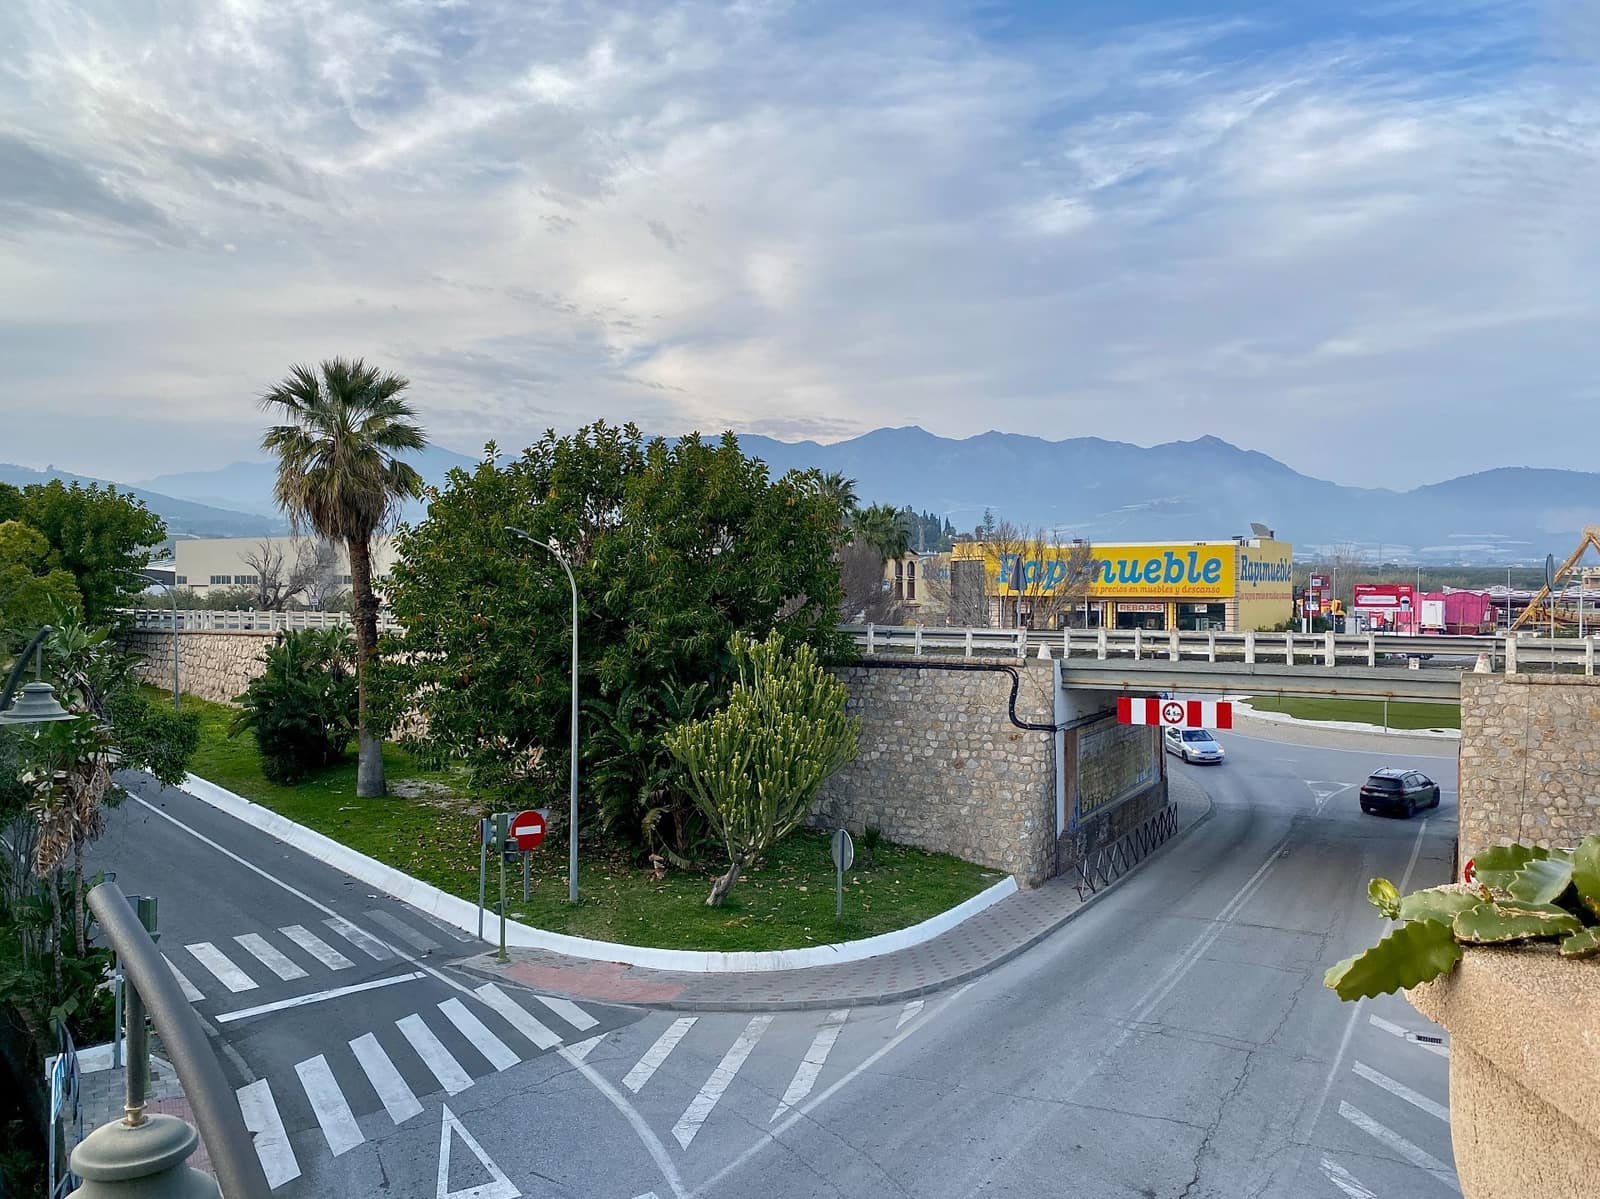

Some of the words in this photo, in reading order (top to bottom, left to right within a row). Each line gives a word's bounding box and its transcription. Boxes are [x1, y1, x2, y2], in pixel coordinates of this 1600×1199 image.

[1240, 554, 1292, 587] Rapimueble
[1128, 586, 1138, 594] en
[1140, 585, 1173, 593] muebles
[1181, 584, 1221, 593] descanso
[1120, 603, 1162, 612] REBAJAS
